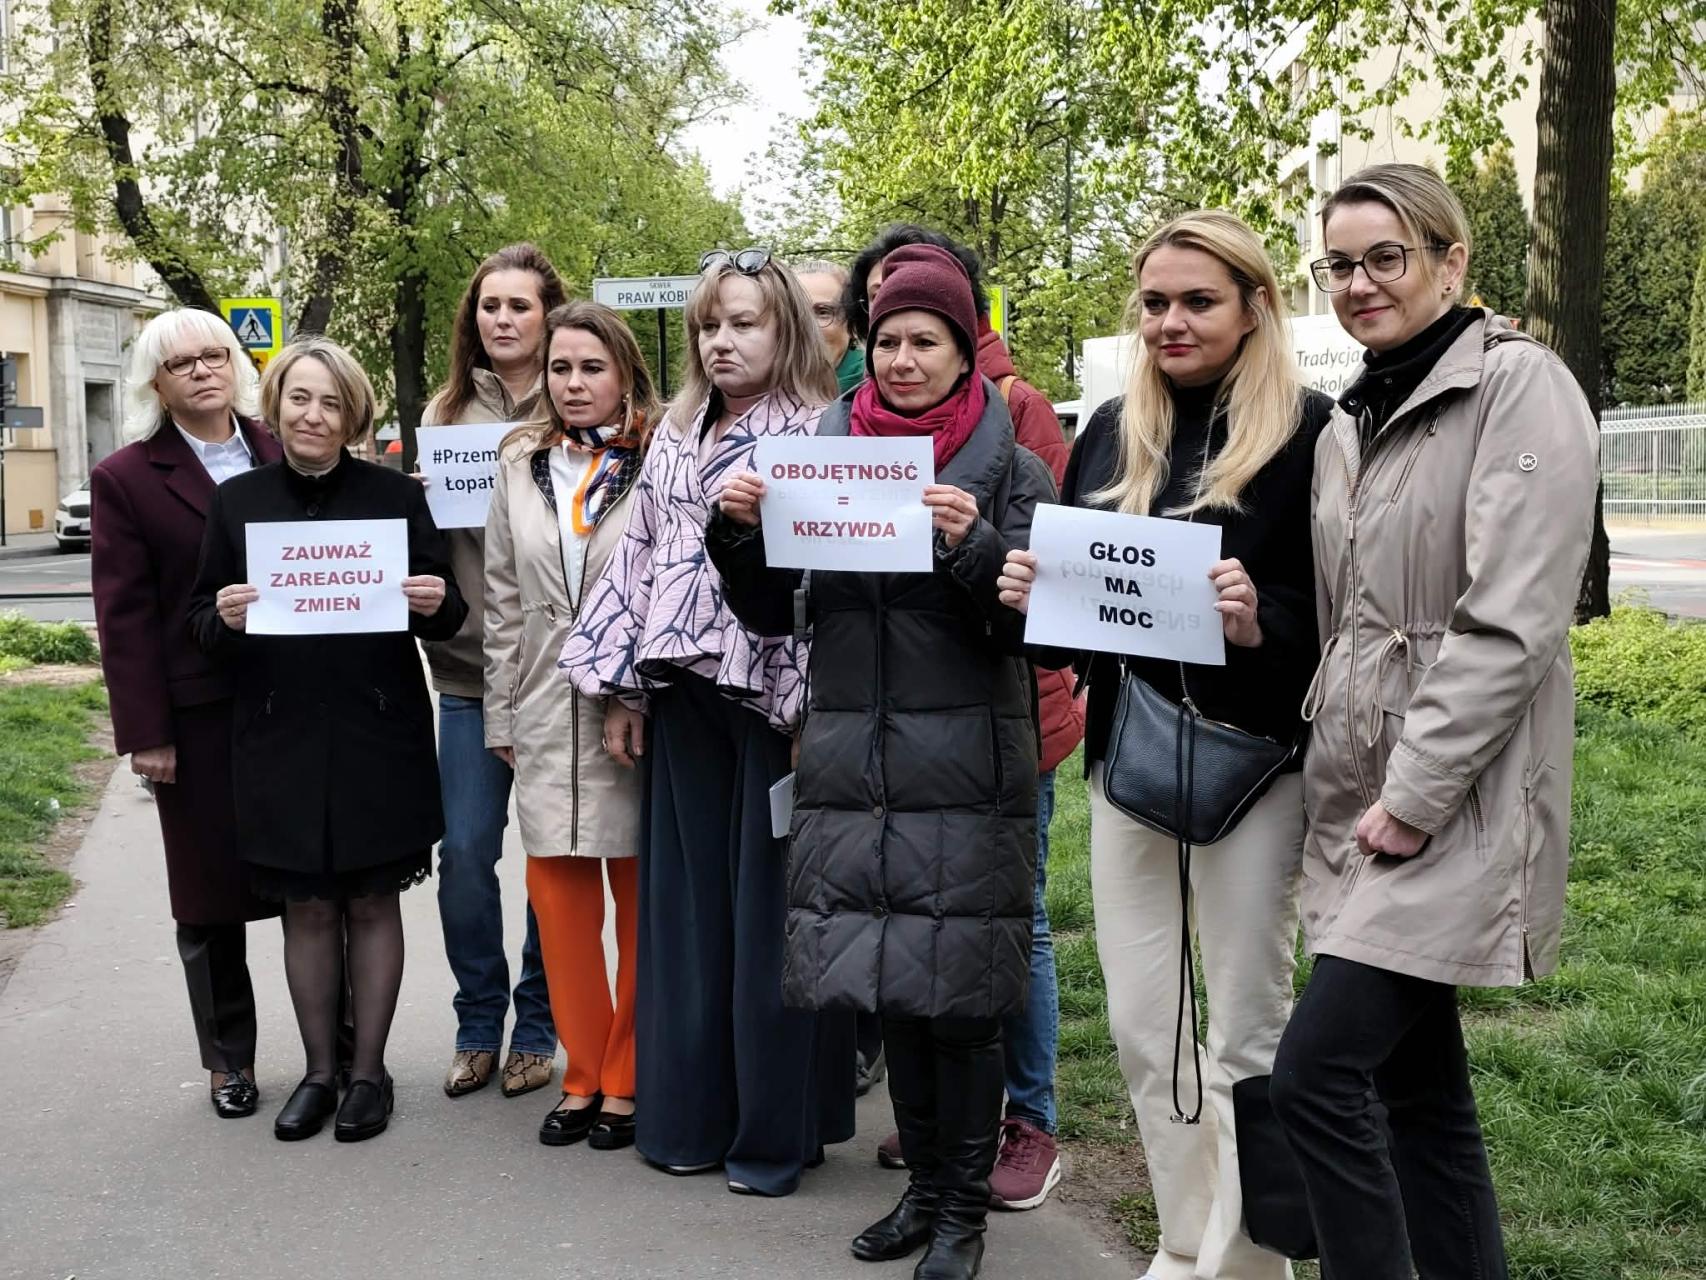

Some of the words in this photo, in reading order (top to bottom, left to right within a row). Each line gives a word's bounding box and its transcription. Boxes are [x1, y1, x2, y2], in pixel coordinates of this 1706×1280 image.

[618, 291, 655, 304] PRAW
[1296, 346, 1360, 368] Tradycja
[771, 461, 918, 484] OBOJĘTNOŚĆ
[445, 473, 497, 494] Łopat
[793, 521, 897, 538] KRZYWDA
[282, 540, 372, 561] ZAUWAŻ
[1089, 541, 1156, 567] GŁOS
[270, 570, 384, 588] ZAREAGUJ
[1105, 576, 1142, 597] MA
[294, 593, 361, 613] ZMIEŃ
[1099, 604, 1154, 629] MOC
